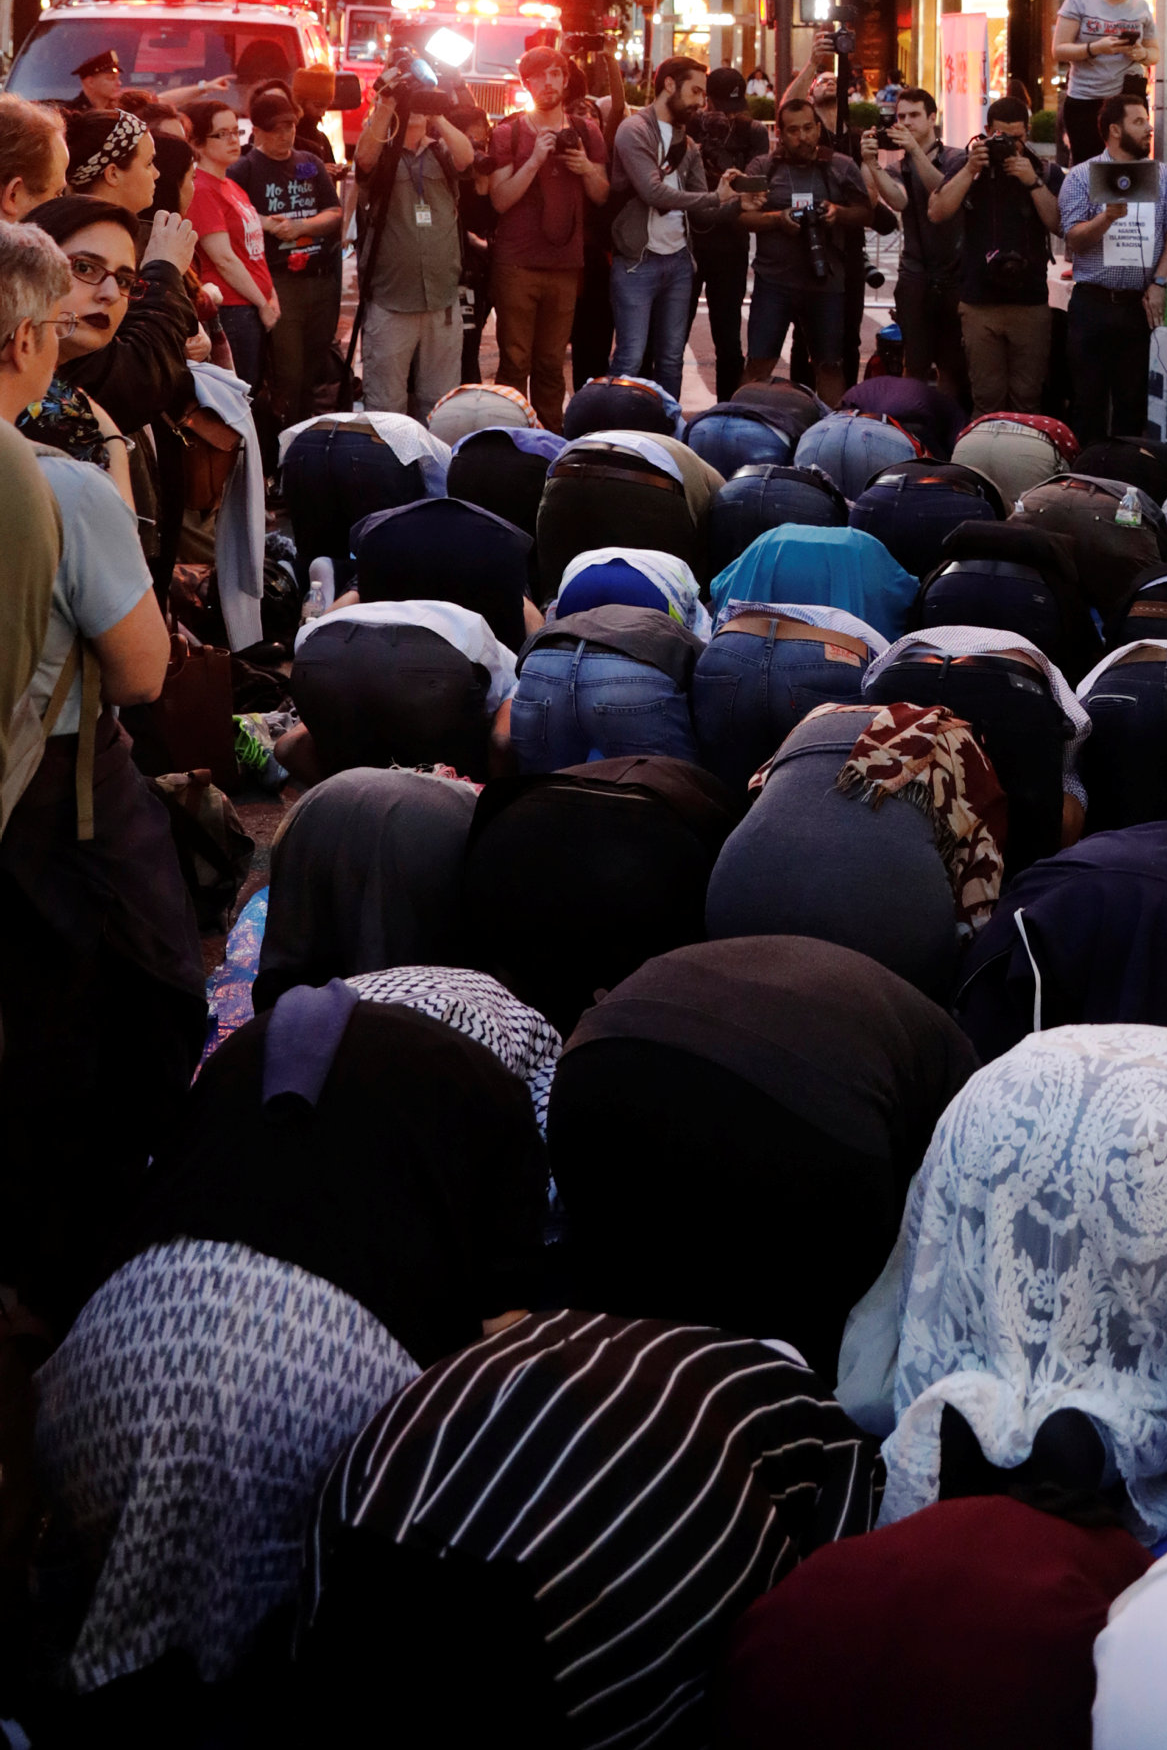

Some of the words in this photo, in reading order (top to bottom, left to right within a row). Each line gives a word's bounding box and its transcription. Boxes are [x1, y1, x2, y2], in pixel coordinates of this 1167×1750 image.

[265, 182, 283, 198] No
[287, 179, 313, 195] Hate
[268, 197, 286, 212] No
[289, 194, 316, 210] Fear
